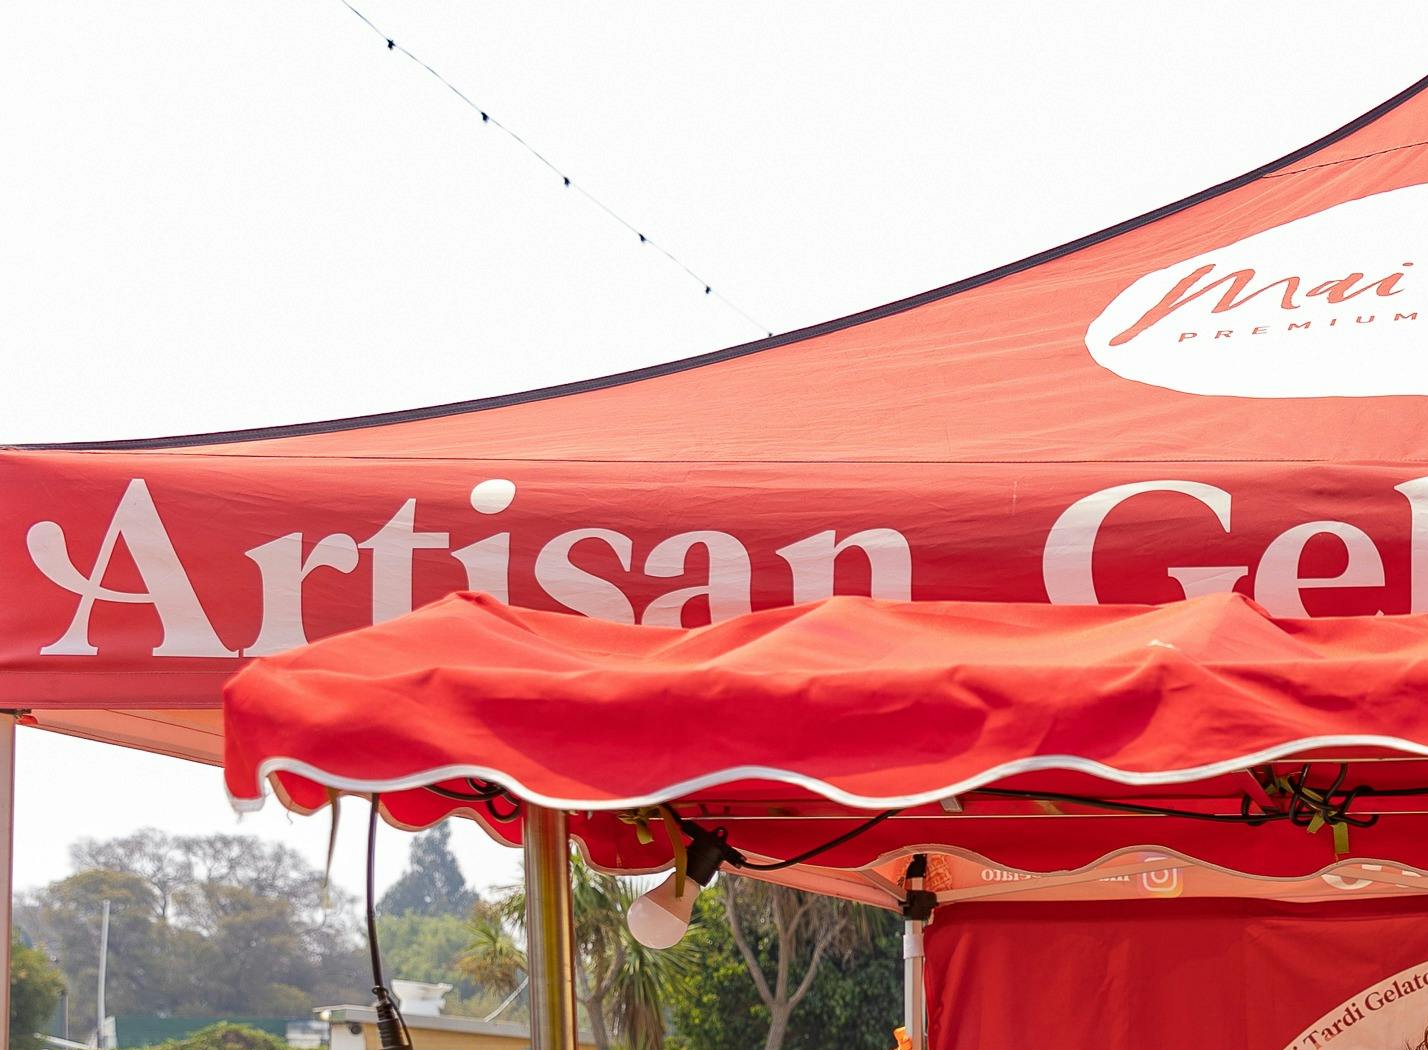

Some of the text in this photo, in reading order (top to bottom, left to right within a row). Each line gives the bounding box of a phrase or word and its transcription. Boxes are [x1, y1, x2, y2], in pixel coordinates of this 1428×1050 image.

[1108, 261, 1414, 347] Mai
[1177, 310, 1418, 343] PREMIUM
[26, 477, 912, 658] Artisan
[1302, 1002, 1366, 1050] Tardi
